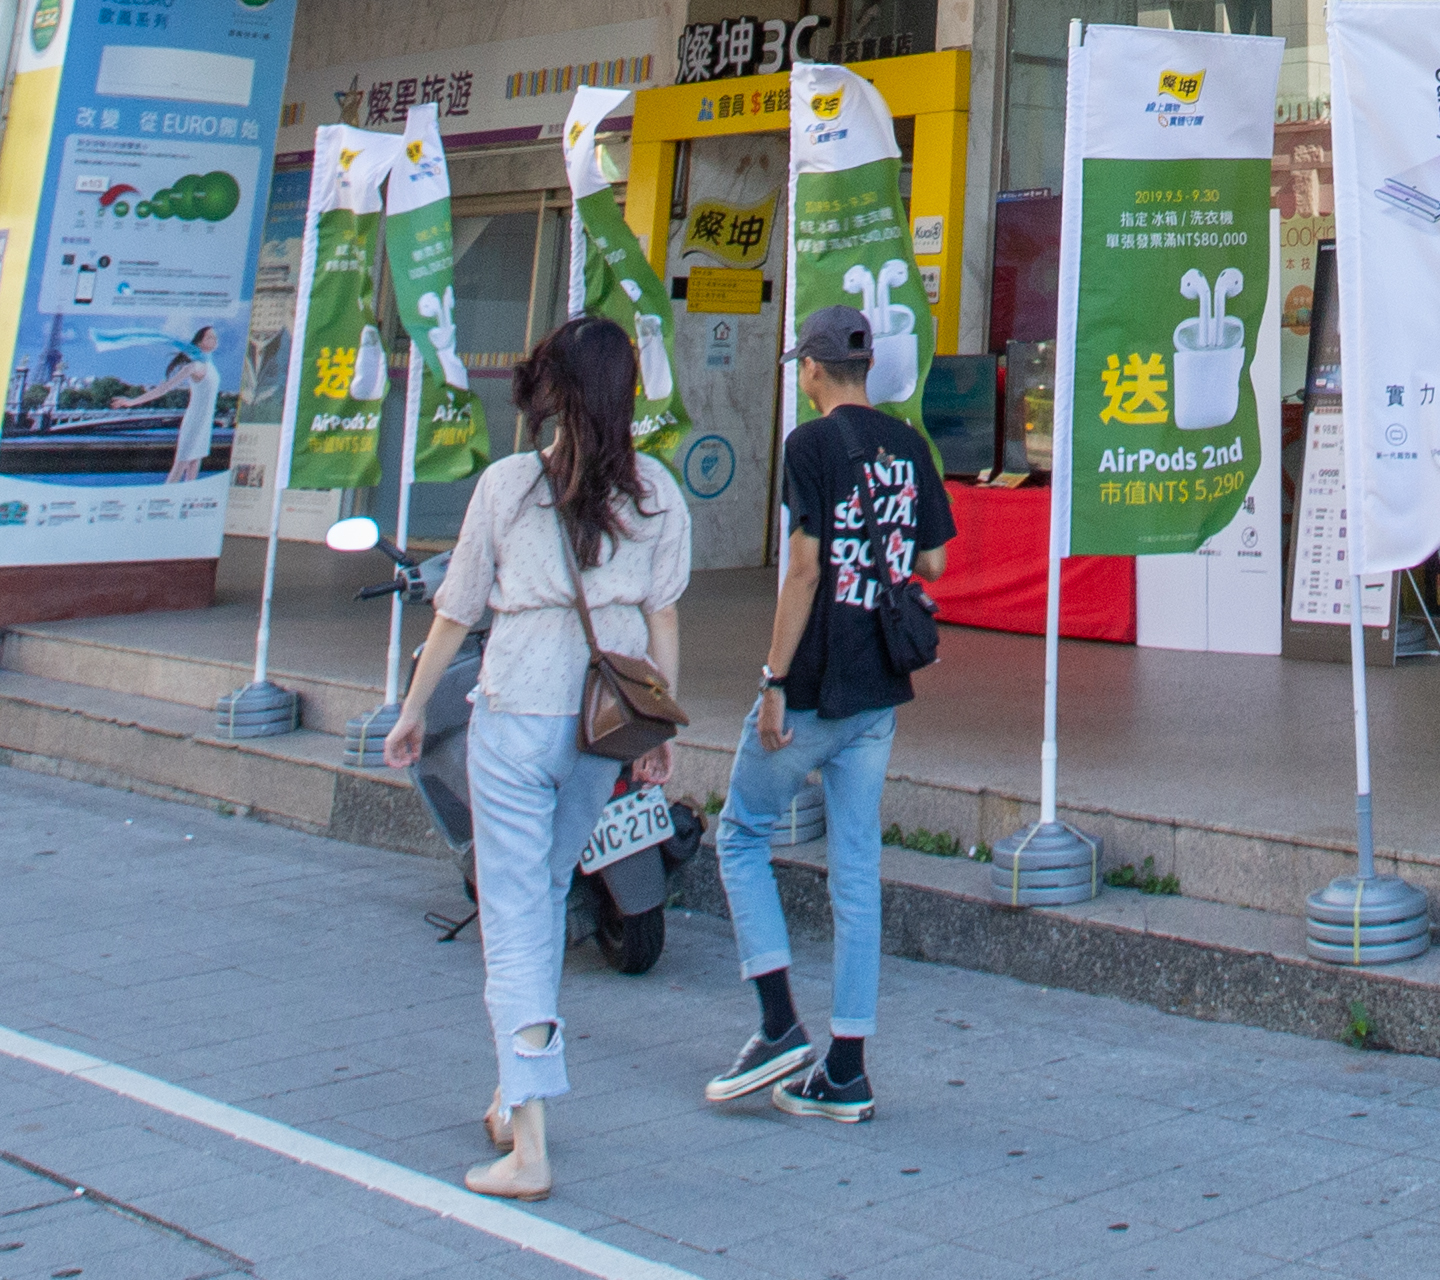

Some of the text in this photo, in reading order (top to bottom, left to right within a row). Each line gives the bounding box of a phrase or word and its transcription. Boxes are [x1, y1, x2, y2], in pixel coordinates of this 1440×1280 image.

[1162, 74, 1198, 97] 燦坤
[718, 94, 745, 118] 會員
[76, 107, 120, 130] 改變
[1120, 211, 1148, 228] 指定
[1151, 211, 1178, 226] 冰箱
[1190, 210, 1234, 226] 洗衣機
[691, 211, 764, 256] 燦坤
[1106, 232, 1248, 249] 單張發票滿NT$80,000
[314, 347, 357, 398] 送
[1099, 352, 1170, 426] 送
[1098, 436, 1244, 473] AirPods 2nd
